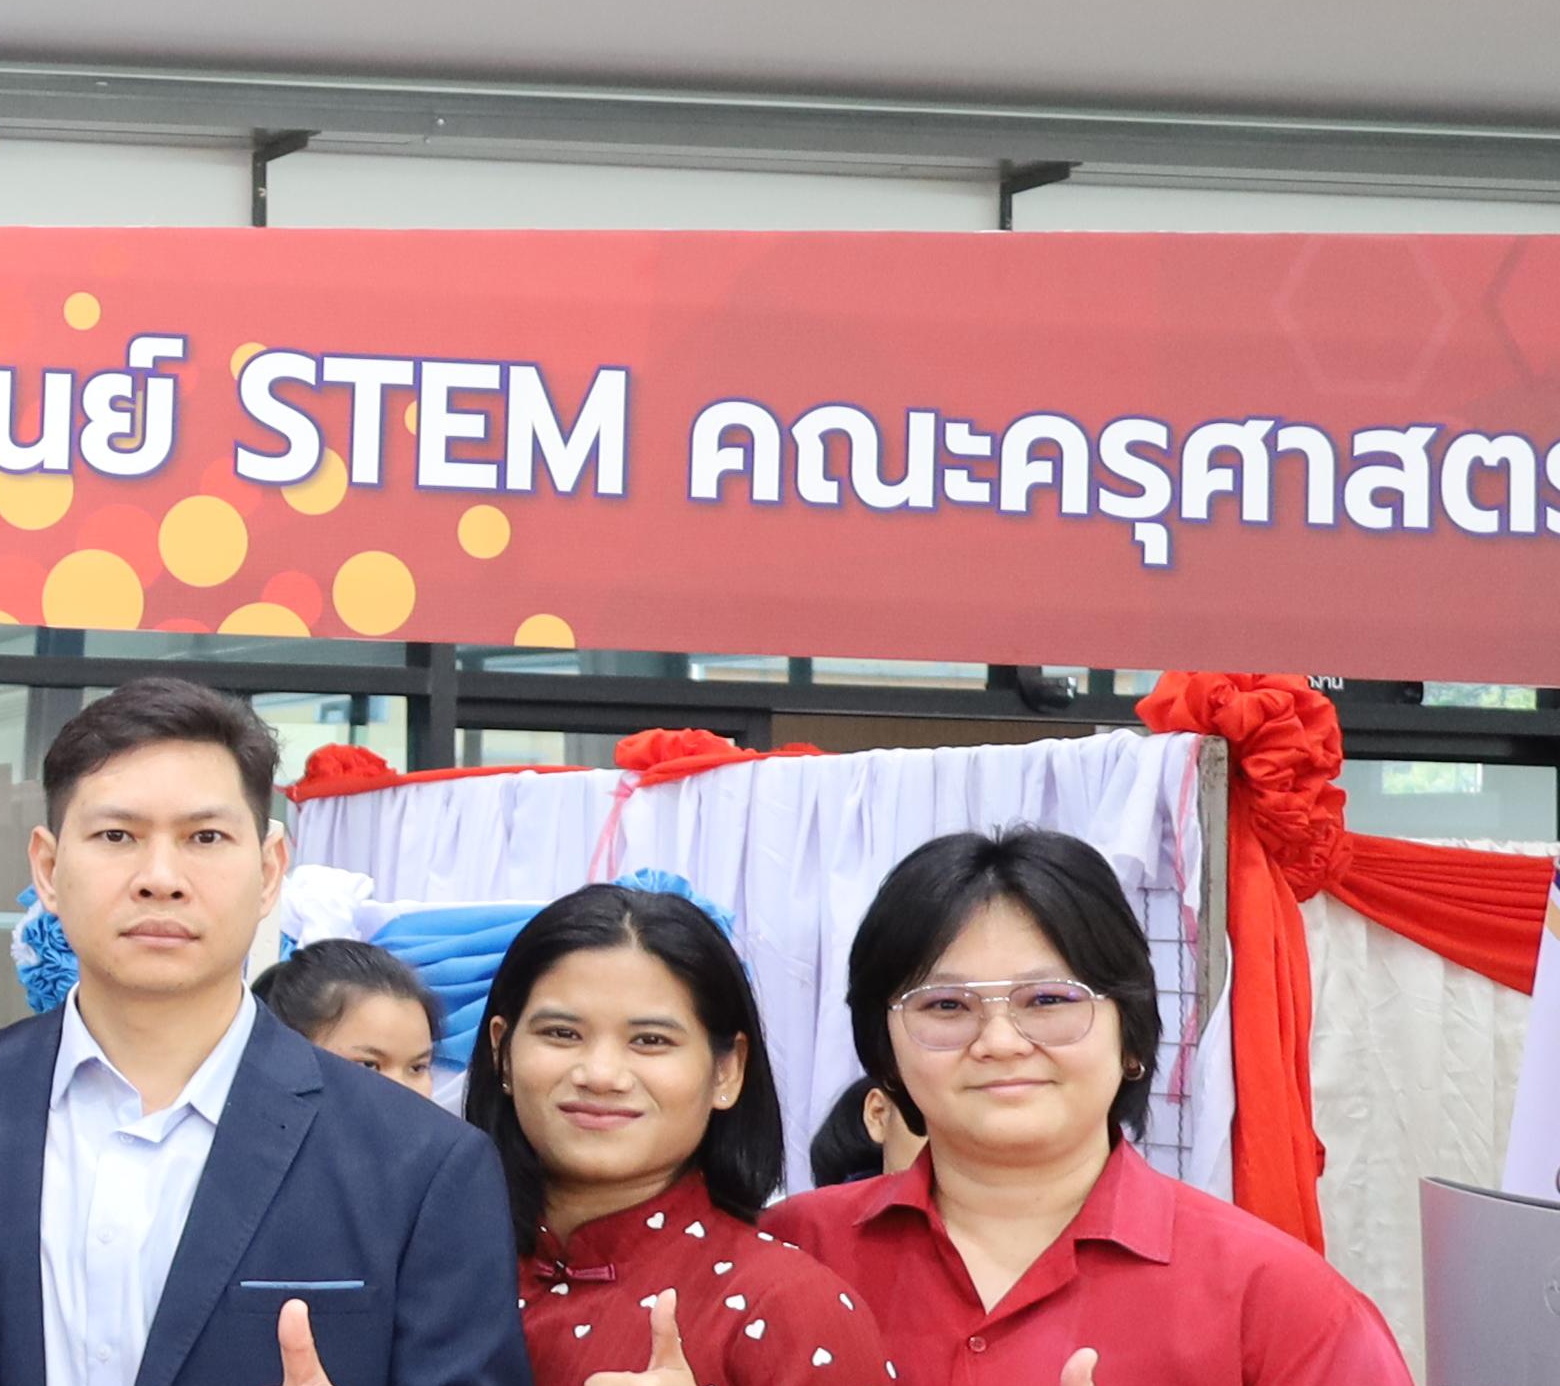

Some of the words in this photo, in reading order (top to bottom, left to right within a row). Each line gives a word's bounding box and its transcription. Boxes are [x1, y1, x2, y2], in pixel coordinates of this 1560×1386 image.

[235, 351, 628, 496] STEM
[690, 400, 1560, 565] คณะครุศาสต
